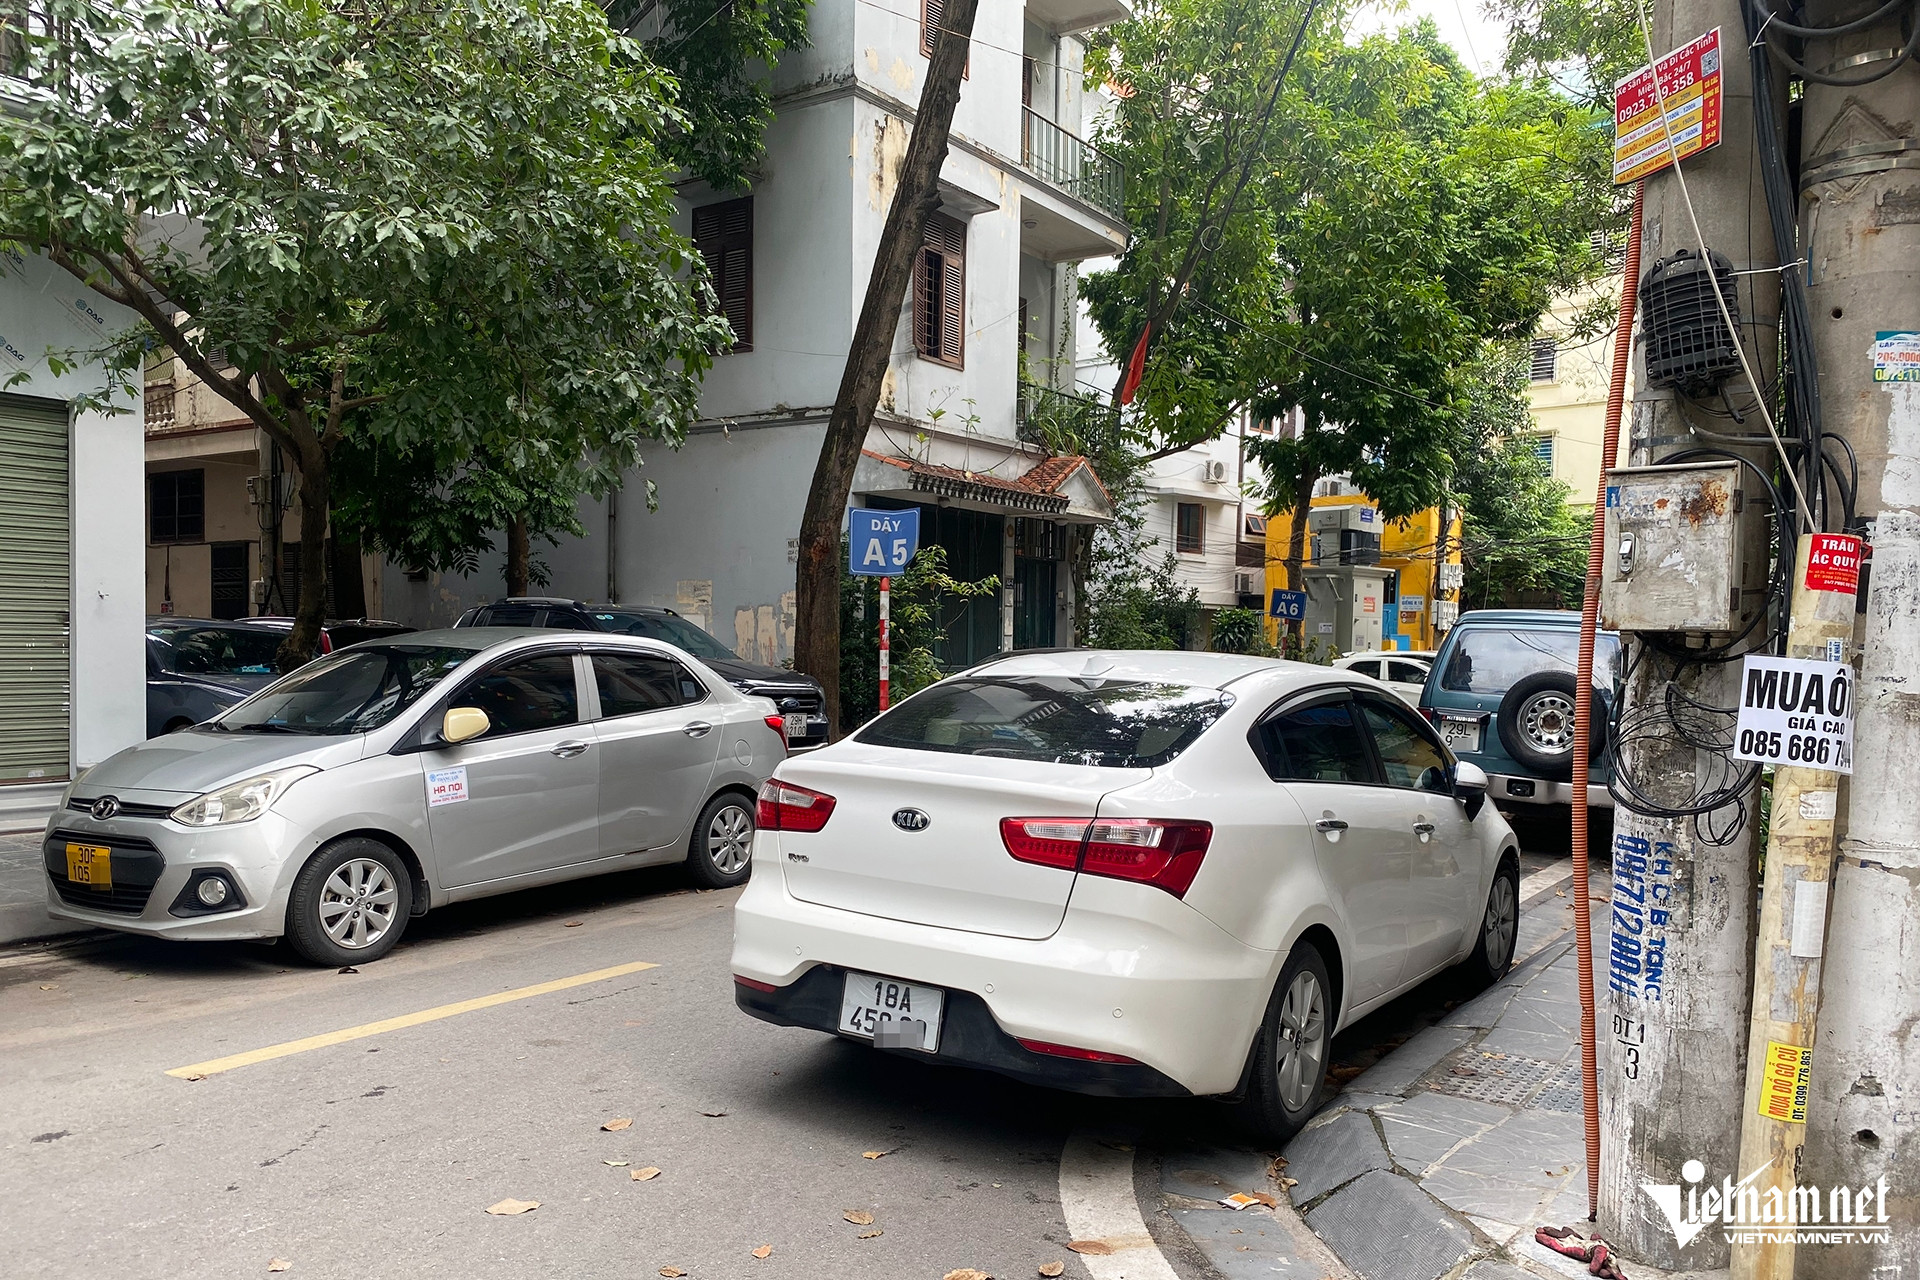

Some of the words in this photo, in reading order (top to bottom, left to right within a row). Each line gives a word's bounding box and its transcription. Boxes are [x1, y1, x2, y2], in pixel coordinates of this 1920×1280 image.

[1616, 86, 1626, 96] Xe
[1627, 79, 1640, 91] Sân
[1642, 70, 1654, 82] Ba
[1658, 62, 1668, 72] Và
[1669, 55, 1678, 66] Đi
[1680, 46, 1694, 60] Các
[1658, 72, 1672, 86] Bắc
[1674, 60, 1692, 78] 24/7
[86, 308, 104, 324] DAG
[5, 344, 26, 362] DAG
[871, 516, 902, 532] DÃY
[1822, 538, 1854, 552] TRÂU
[1282, 592, 1296, 600] DÃY
[790, 716, 802, 726] 29H
[1448, 722, 1471, 736] 29L
[1788, 716, 1816, 732] GIÁ
[1822, 720, 1846, 736] CAO
[1740, 729, 1782, 758] 085
[1788, 734, 1830, 764] 686
[896, 812, 922, 828] KIA
[874, 981, 911, 1012] 18A
[1774, 1046, 1798, 1062] CŨ
[1794, 1050, 1812, 1106] 0399.776.863
[1768, 1094, 1791, 1118] MUA
